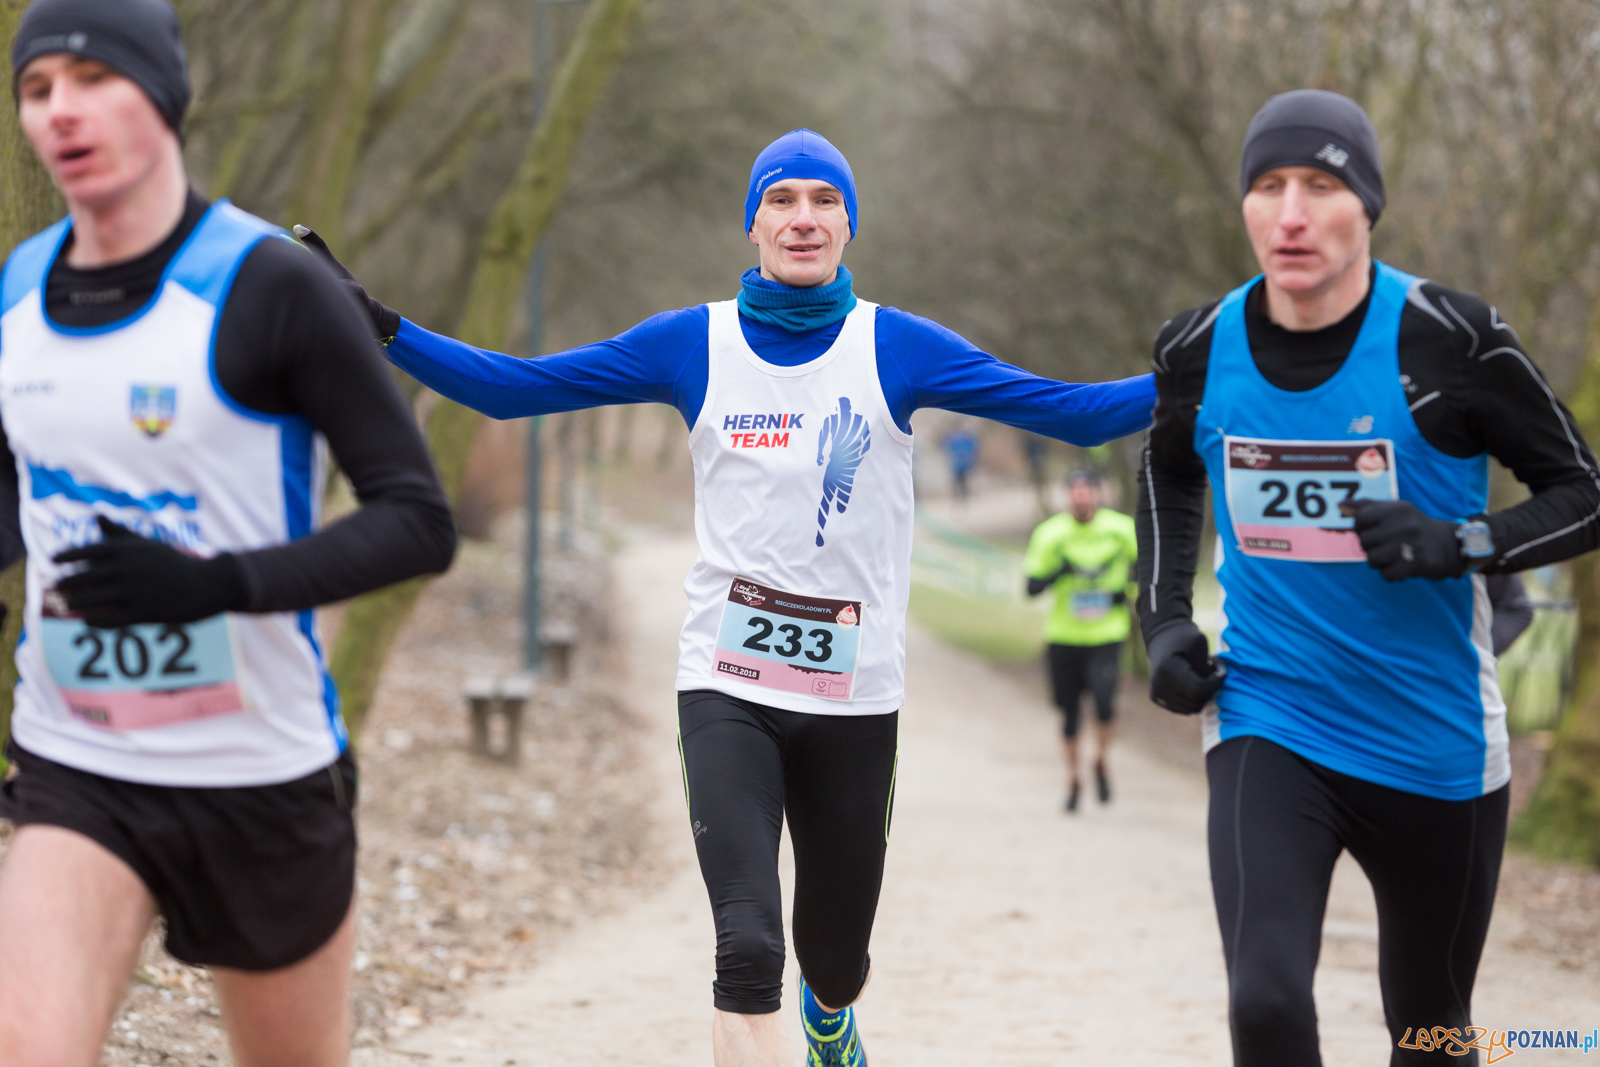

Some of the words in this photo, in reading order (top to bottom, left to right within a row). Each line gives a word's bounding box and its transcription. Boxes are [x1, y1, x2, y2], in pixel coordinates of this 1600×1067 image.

[723, 413, 805, 430] HERNIK
[730, 432, 790, 448] TEAM
[1259, 480, 1361, 518] 267
[73, 626, 198, 679] 202
[742, 616, 834, 663] 233
[719, 662, 758, 679] 11.02.2018
